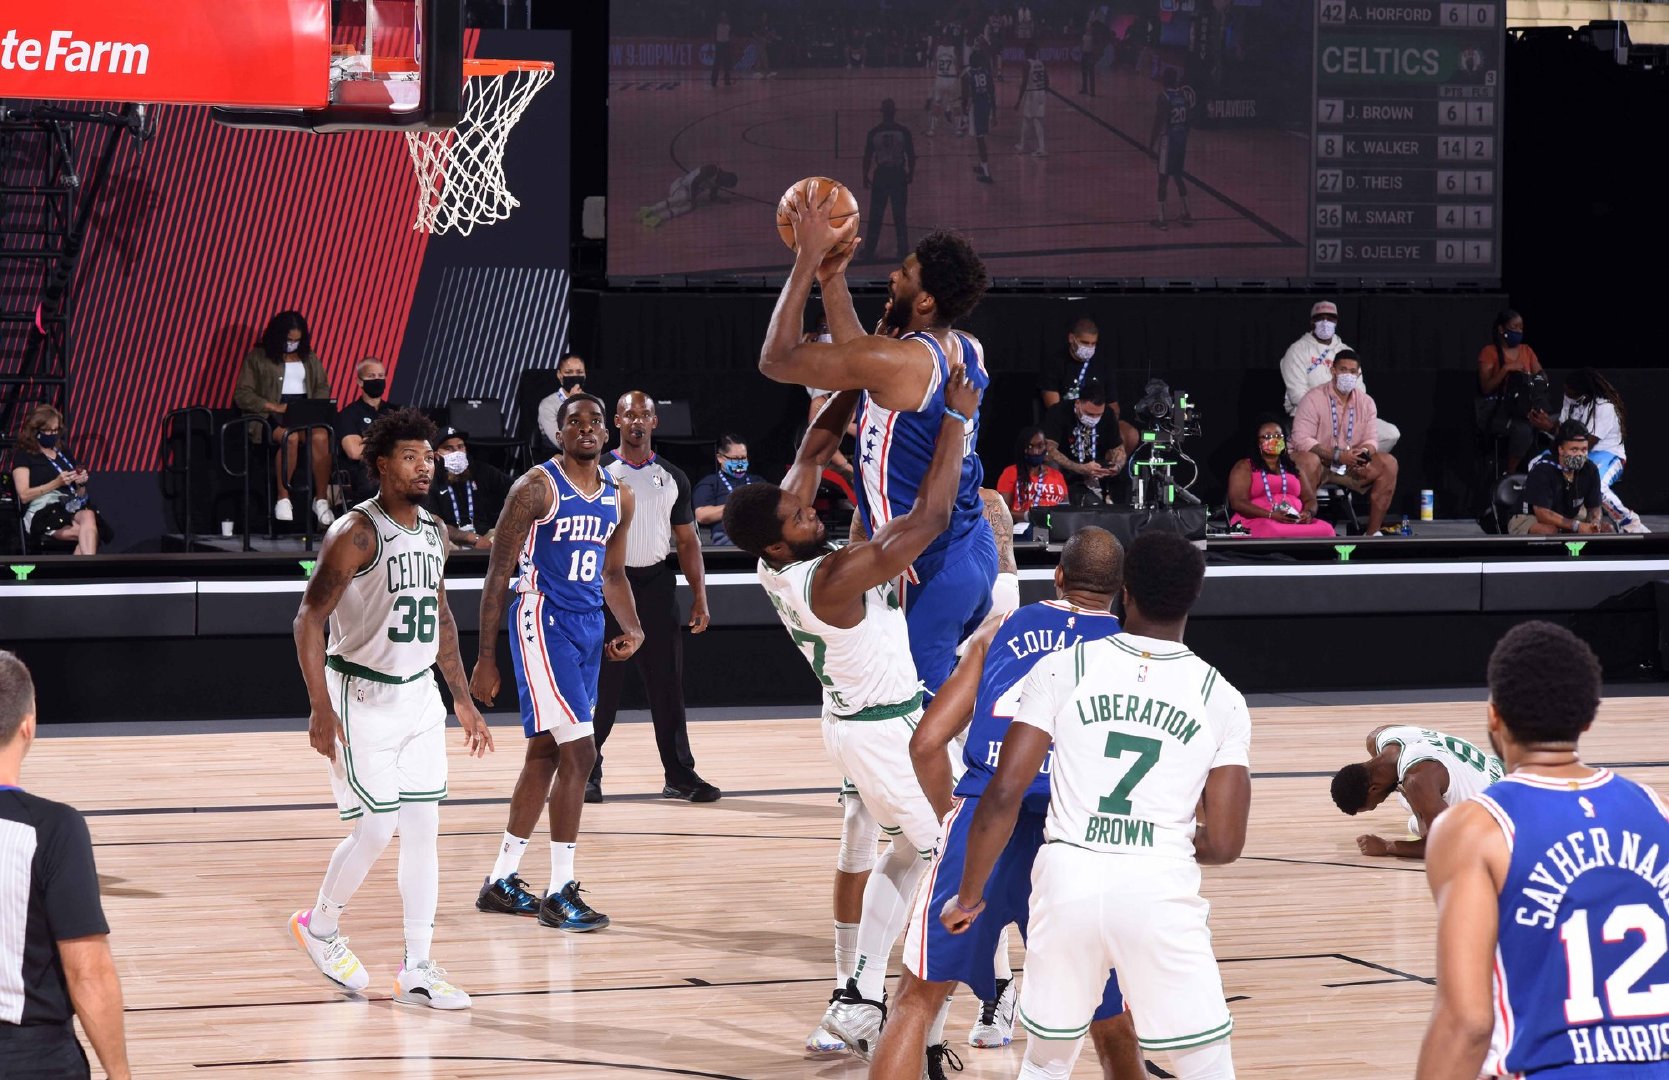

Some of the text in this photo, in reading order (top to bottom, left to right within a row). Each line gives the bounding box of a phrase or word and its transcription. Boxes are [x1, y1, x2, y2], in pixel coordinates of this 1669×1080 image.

[1322, 5, 1487, 22] 42 A. HORFORD 6 0
[1322, 46, 1440, 75] CELTICS
[974, 73, 987, 87] 18
[1215, 99, 1256, 118] PLAYOFFS
[1325, 105, 1484, 121] 7 J. BROWN 6 1
[1325, 139, 1484, 156] 8 K. WALKER 14 2
[1319, 174, 1482, 191] 27 D. THEIS 6 1
[1318, 209, 1481, 226] 36 M. SMART 4 1
[1317, 244, 1481, 260] 37 S. OJELEYE 0 1
[568, 549, 597, 582] 18
[387, 596, 438, 643] 36
[1076, 694, 1201, 745] LIBERATION
[1444, 736, 1486, 773] 8
[1097, 731, 1162, 816] 7
[1085, 816, 1155, 847] BROWN
[1559, 903, 1669, 1024] 12
